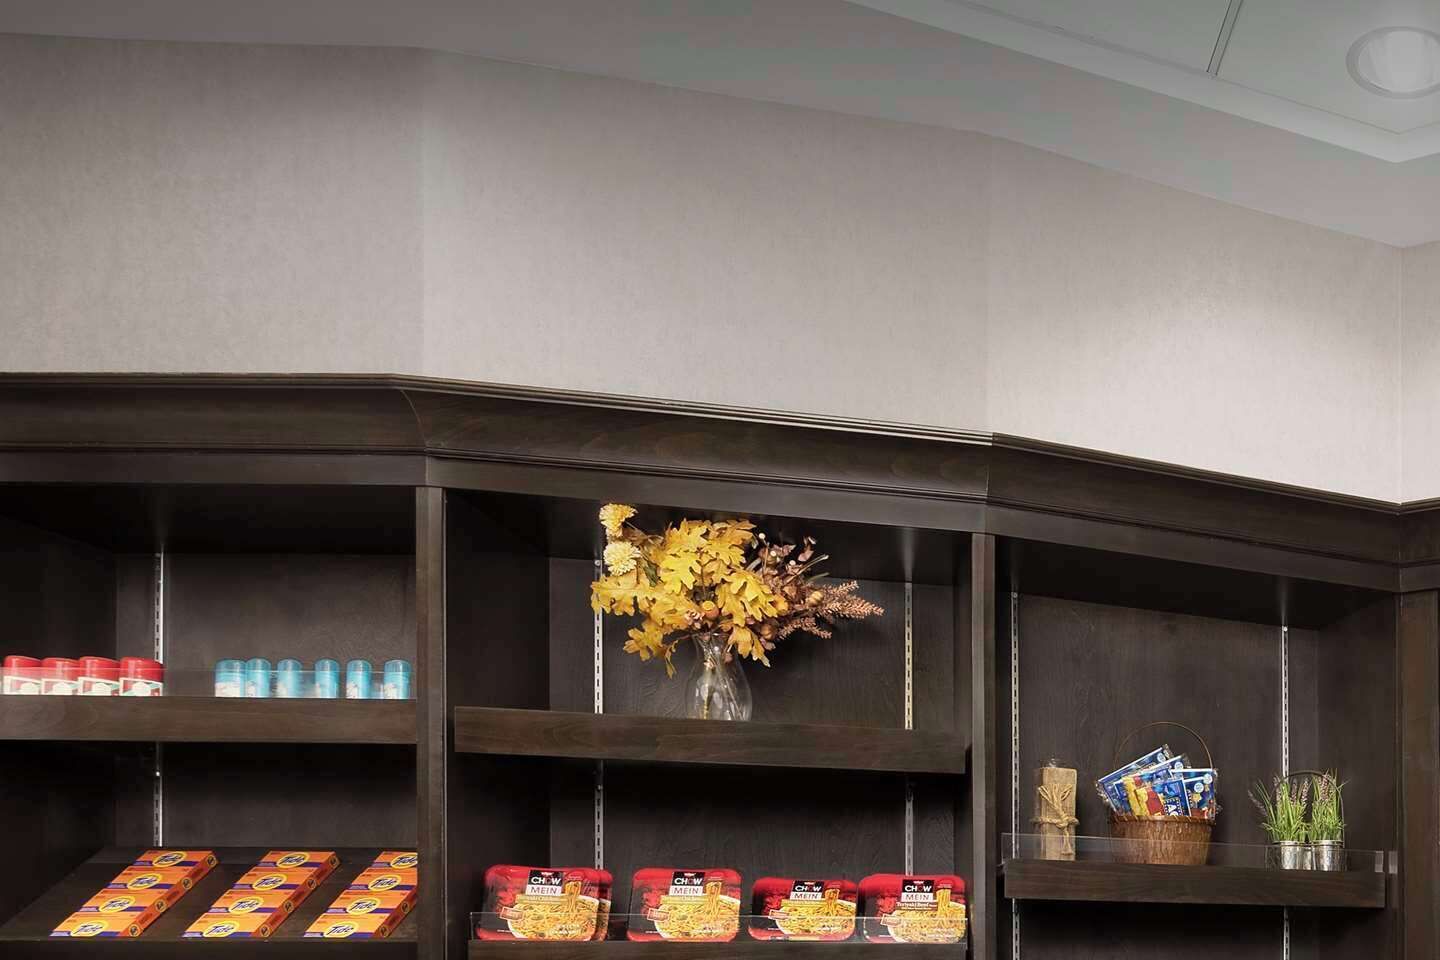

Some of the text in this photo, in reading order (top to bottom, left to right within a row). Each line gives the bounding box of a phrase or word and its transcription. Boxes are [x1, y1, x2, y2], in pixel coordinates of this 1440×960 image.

[257, 875, 282, 888] Tide
[372, 877, 397, 889] Tide
[530, 876, 562, 885] CHOW
[674, 877, 703, 886] CHOW
[530, 886, 557, 895] MEIN
[673, 887, 699, 895] MEIN
[104, 899, 129, 911] Tide
[233, 899, 259, 911] Tide
[349, 900, 376, 912] Tide
[76, 924, 103, 935] Tide
[208, 923, 236, 936] Tide
[327, 923, 353, 936] Tide
